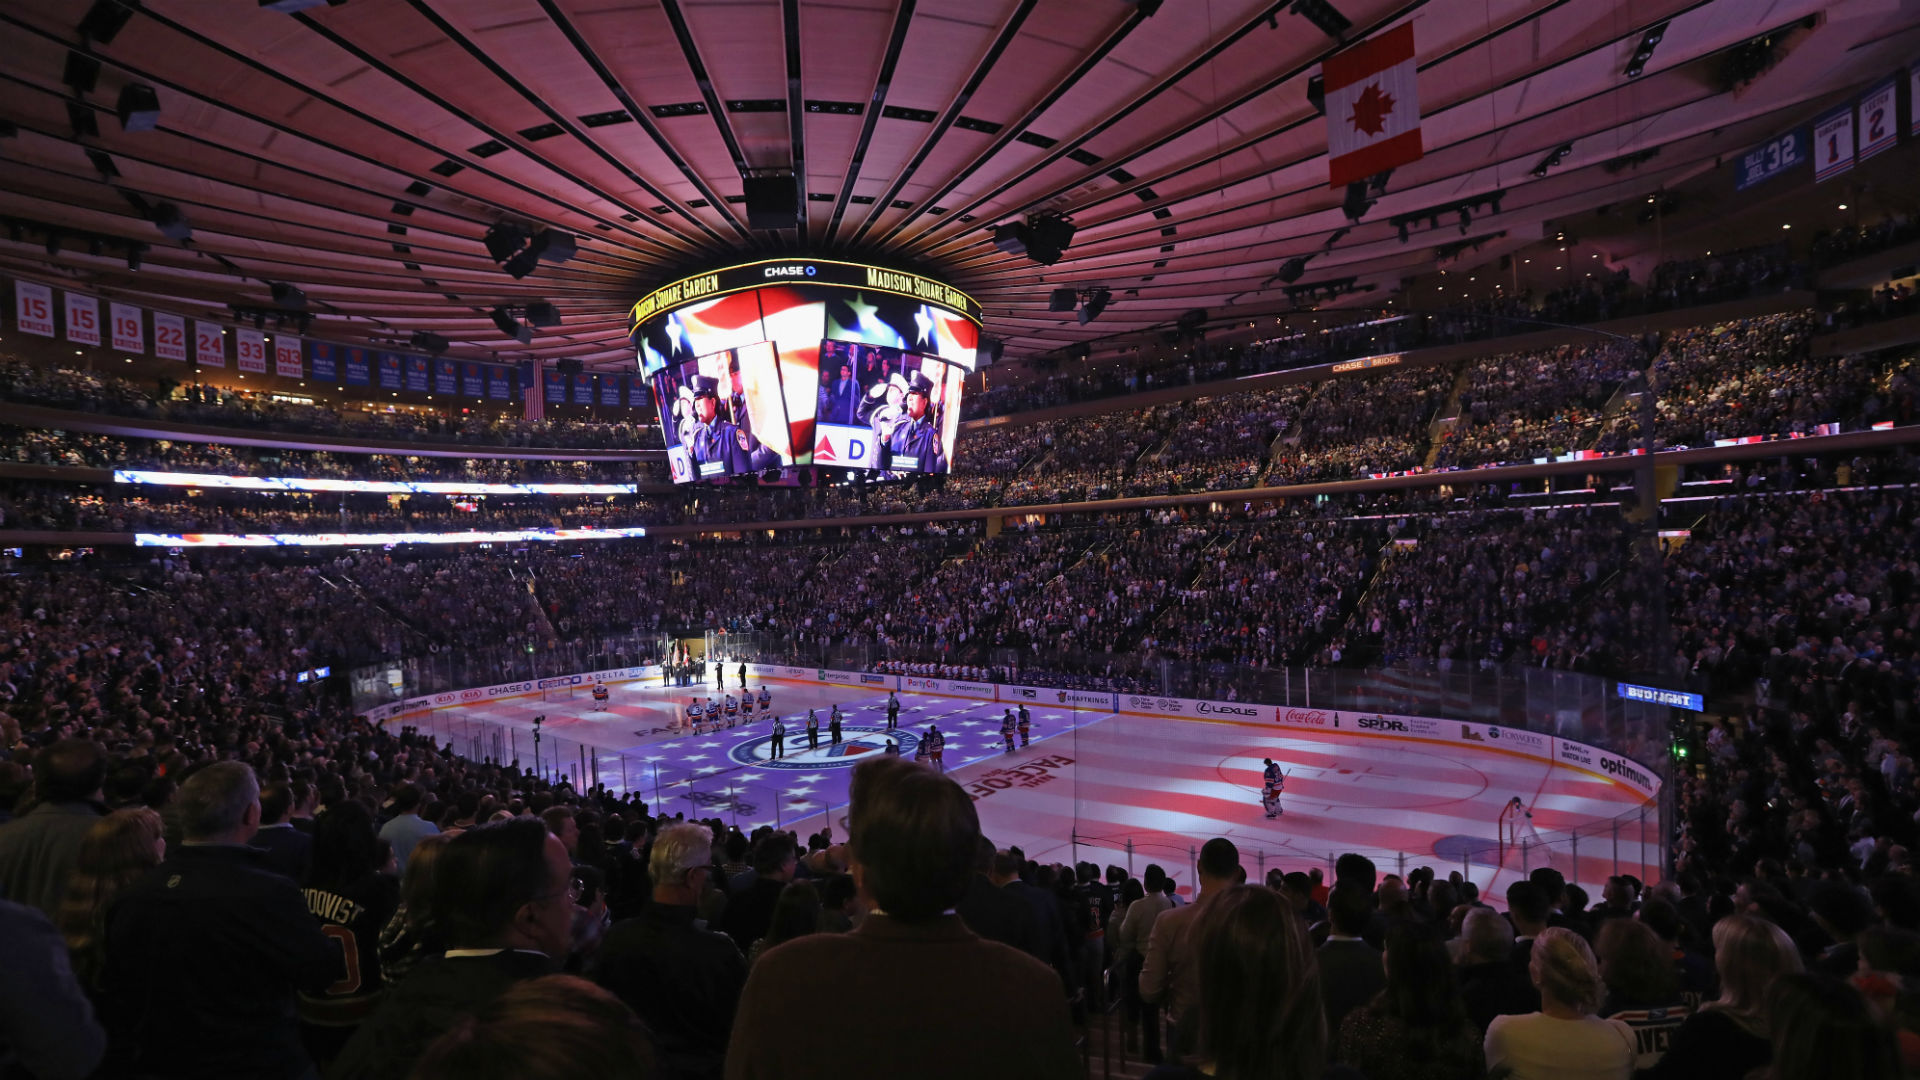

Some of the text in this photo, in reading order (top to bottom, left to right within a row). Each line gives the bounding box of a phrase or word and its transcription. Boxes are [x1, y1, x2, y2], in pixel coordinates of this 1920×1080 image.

[1869, 107, 1884, 143] 2
[1744, 147, 1765, 169] BILLY
[1767, 134, 1796, 171] 32
[1828, 133, 1839, 165] 1
[764, 266, 804, 277] CHASE
[683, 274, 719, 299] GARDEN
[867, 268, 912, 294] MADISON
[914, 277, 944, 303] SQUARE
[23, 297, 47, 320] 15
[71, 308, 95, 330] 15
[116, 317, 138, 338] 19
[157, 326, 183, 347] 22
[199, 334, 222, 354] 24
[239, 341, 263, 360] 33
[276, 346, 302, 366] 613
[1332, 355, 1400, 373] CHASE BRIDGE
[537, 675, 582, 690] GEICO
[595, 671, 625, 681] DELTA
[436, 693, 453, 703] KIA
[462, 690, 479, 699] KIA
[488, 684, 522, 696] CHASE
[1628, 686, 1652, 699] BUD
[1212, 706, 1257, 716] LEXUS
[1561, 751, 1592, 765] WATCH LIVE
